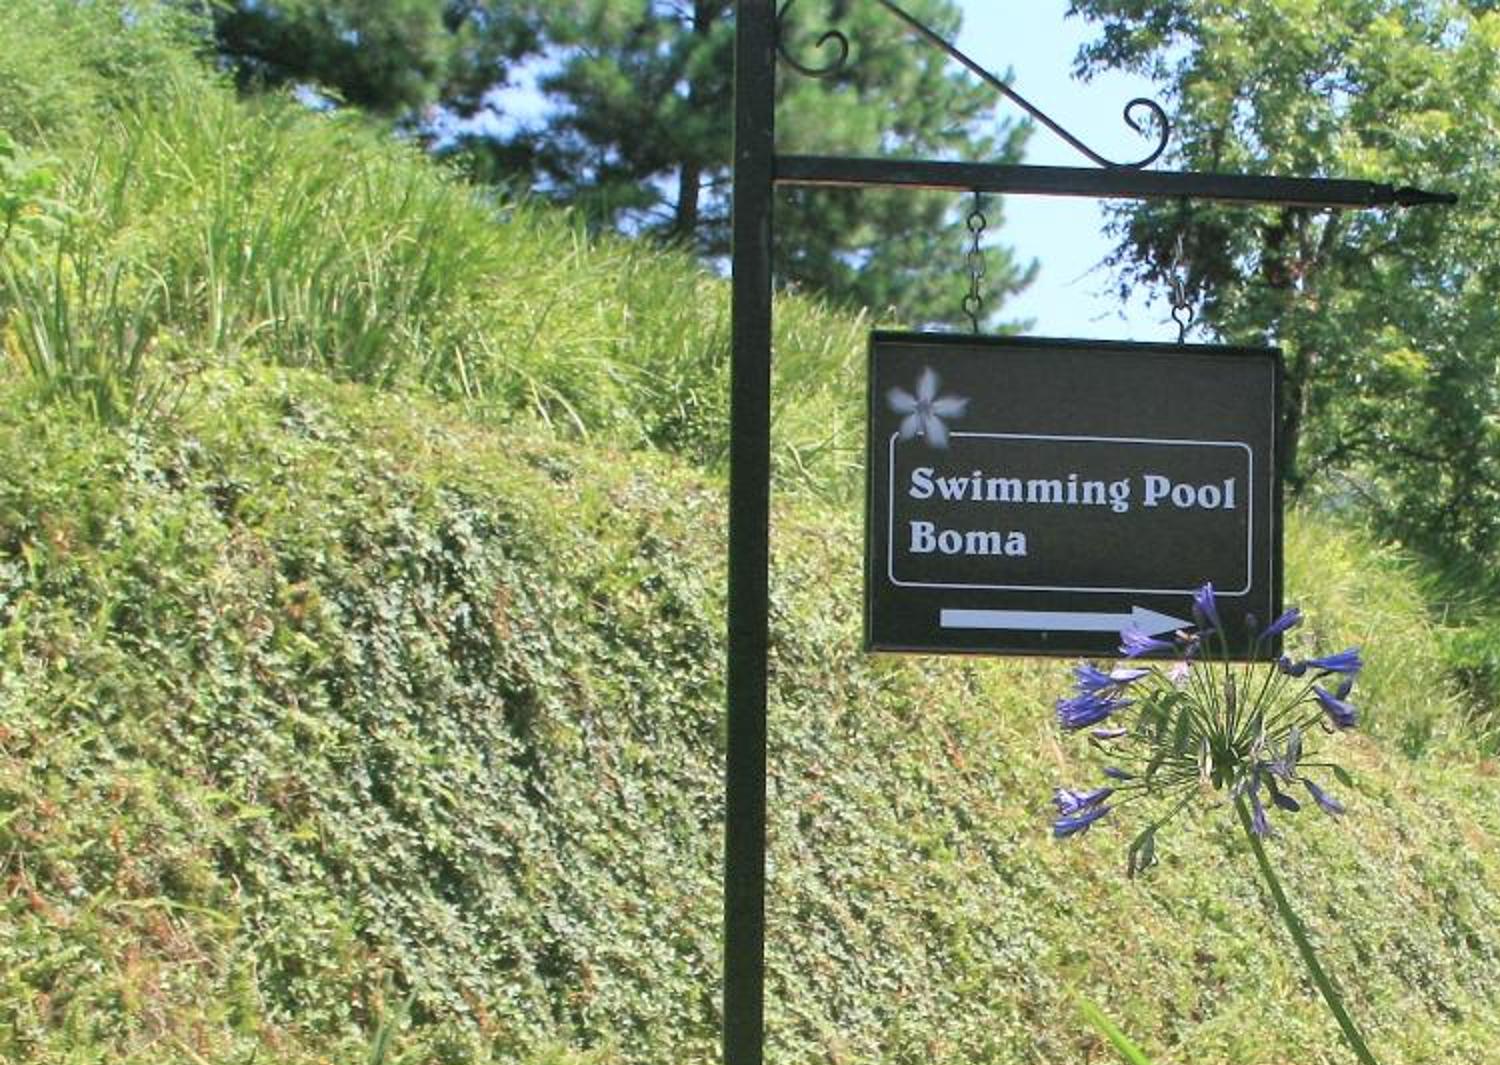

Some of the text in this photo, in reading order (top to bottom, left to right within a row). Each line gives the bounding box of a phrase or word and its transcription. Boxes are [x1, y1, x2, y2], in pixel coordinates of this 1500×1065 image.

[908, 467, 1236, 513] Swimming Pool
[908, 521, 1028, 557] Boma
